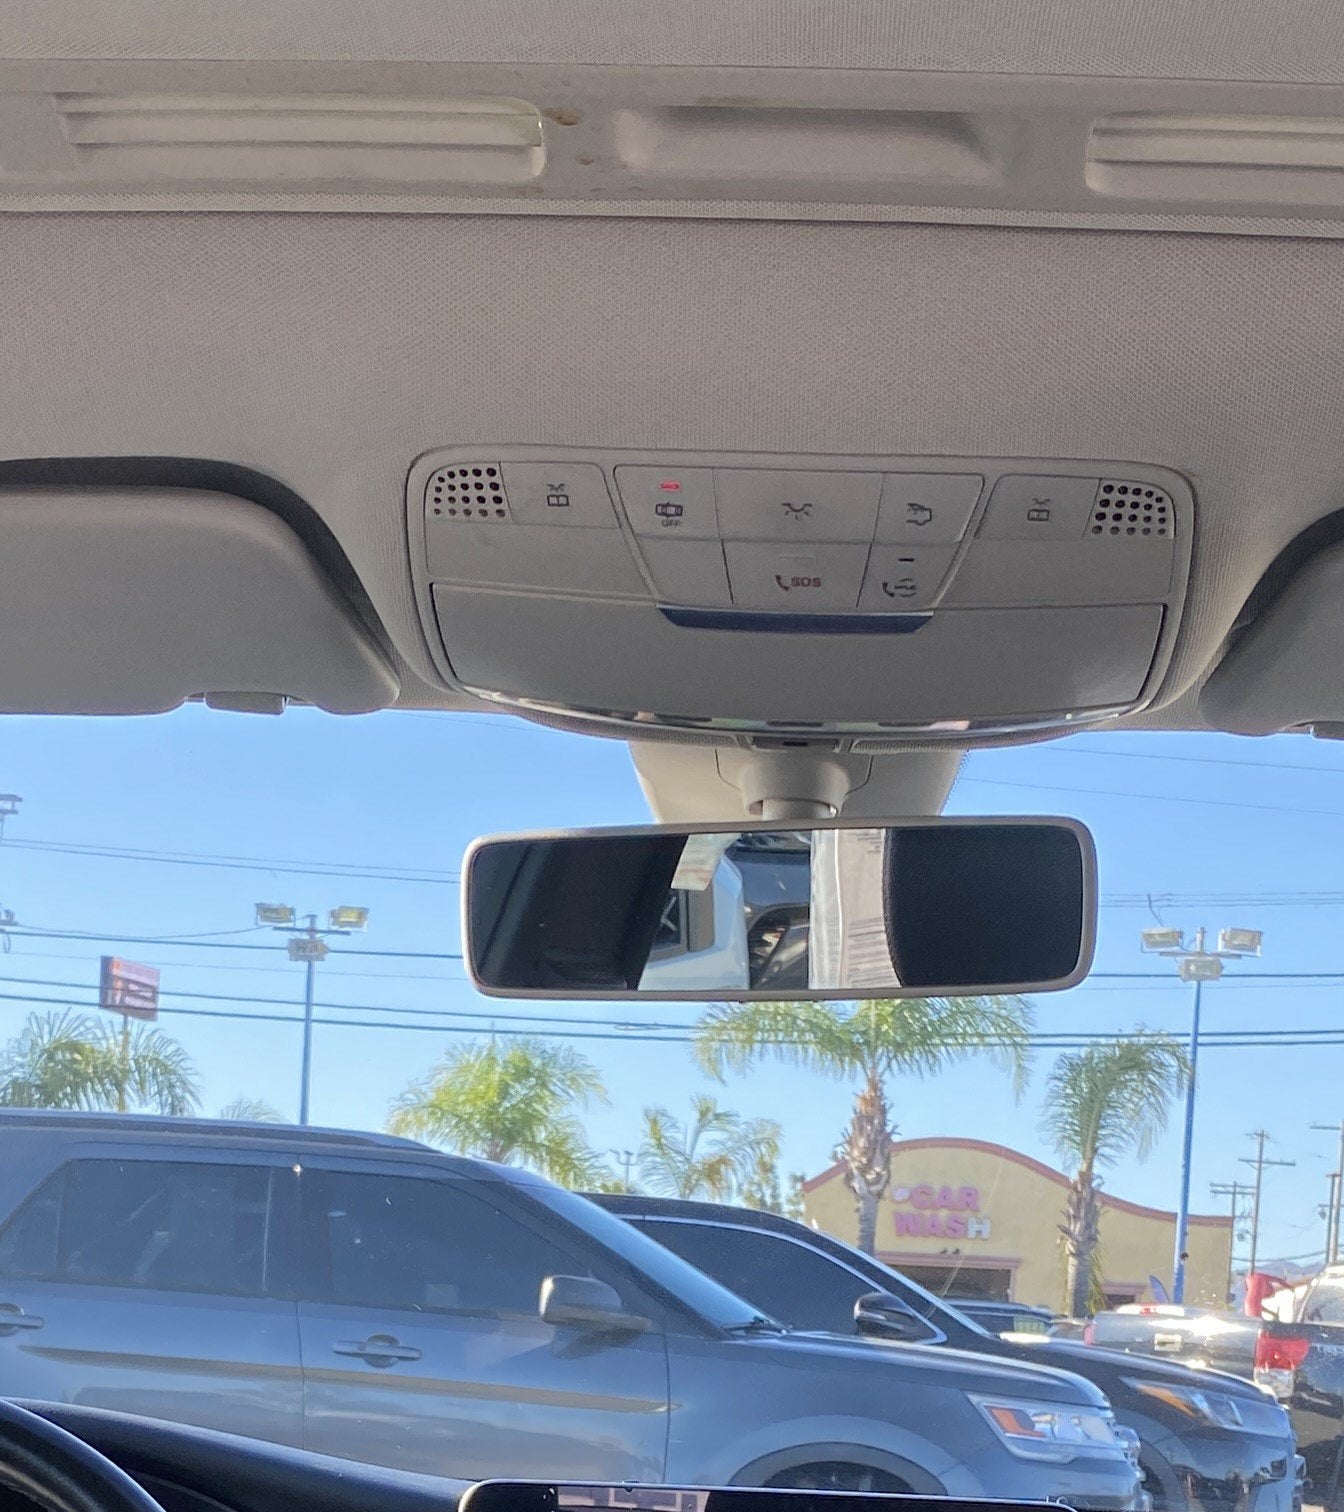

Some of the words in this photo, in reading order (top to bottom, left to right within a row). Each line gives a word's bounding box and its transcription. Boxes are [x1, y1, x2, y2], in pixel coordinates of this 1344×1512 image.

[791, 577, 821, 588] SOS
[910, 1184, 980, 1212] CAR
[893, 1211, 990, 1240] WASH
